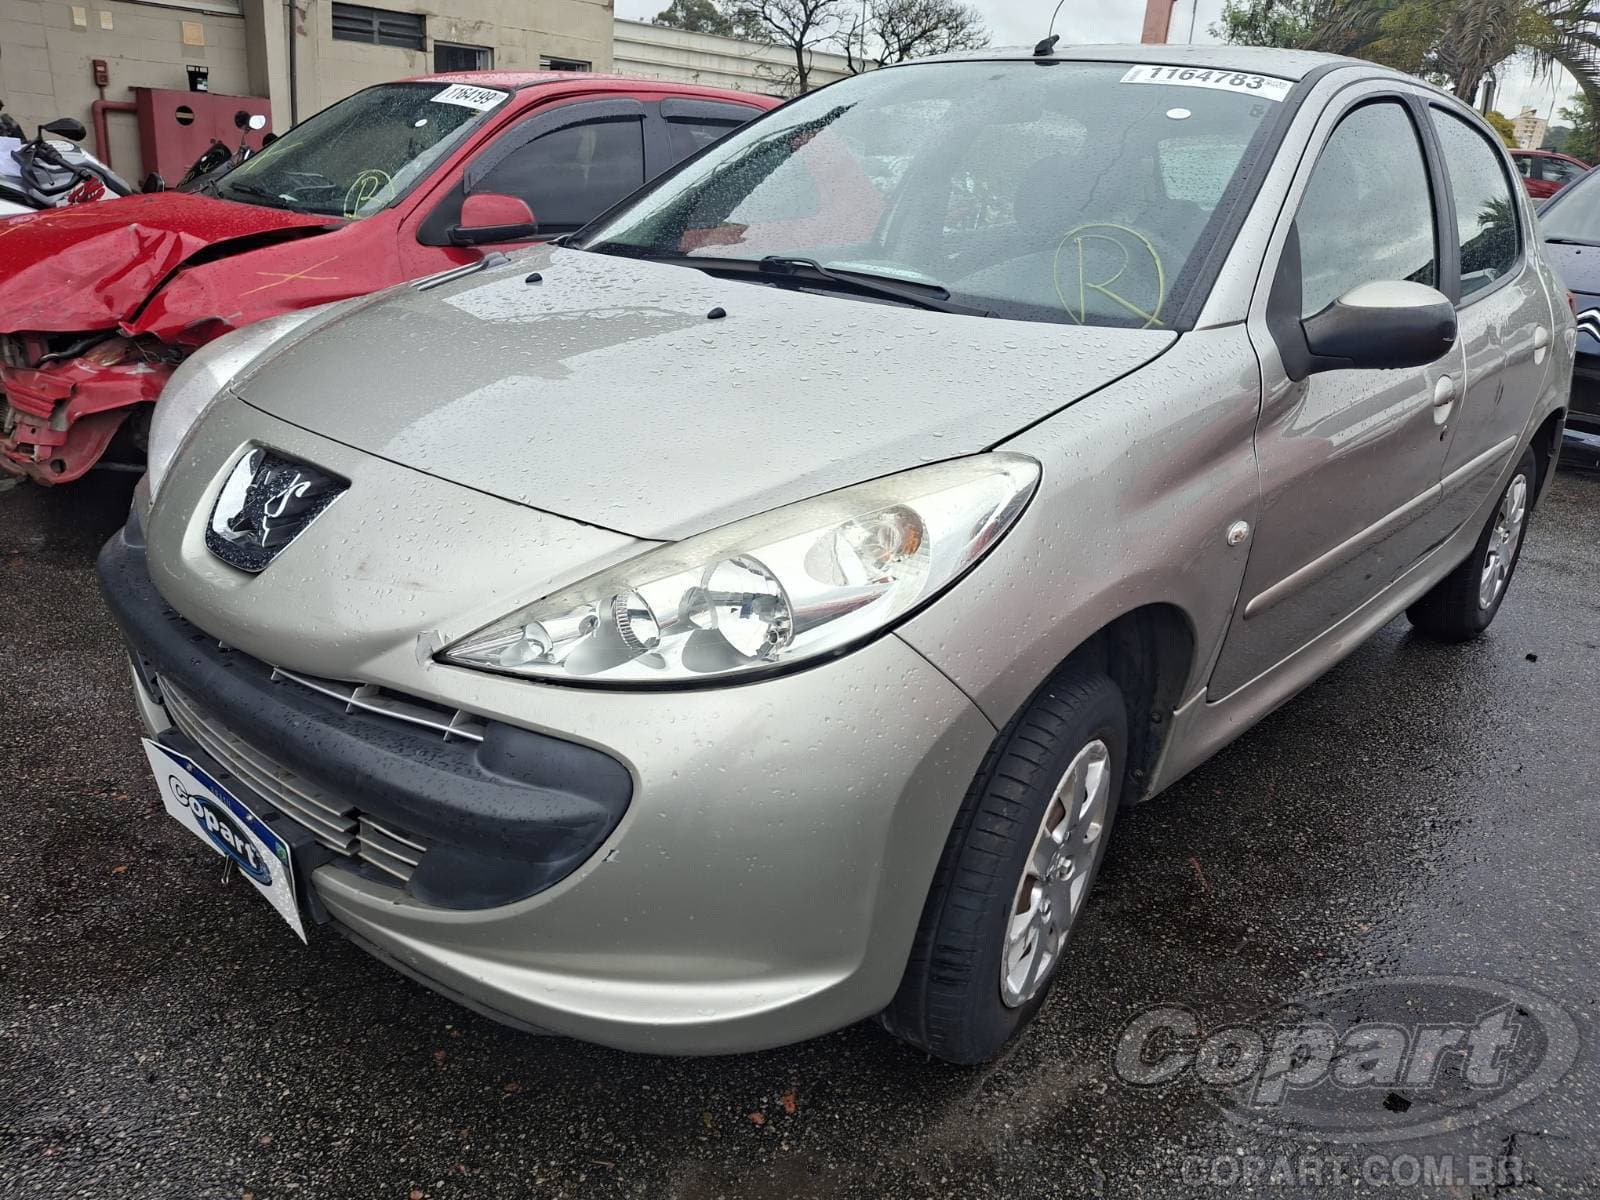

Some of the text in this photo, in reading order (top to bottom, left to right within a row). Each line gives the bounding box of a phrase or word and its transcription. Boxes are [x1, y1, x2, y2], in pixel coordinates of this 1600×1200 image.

[446, 87, 497, 104] 1164199
[1150, 67, 1265, 90] 1164783
[1074, 234, 1164, 326] R
[168, 774, 260, 869] Copart
